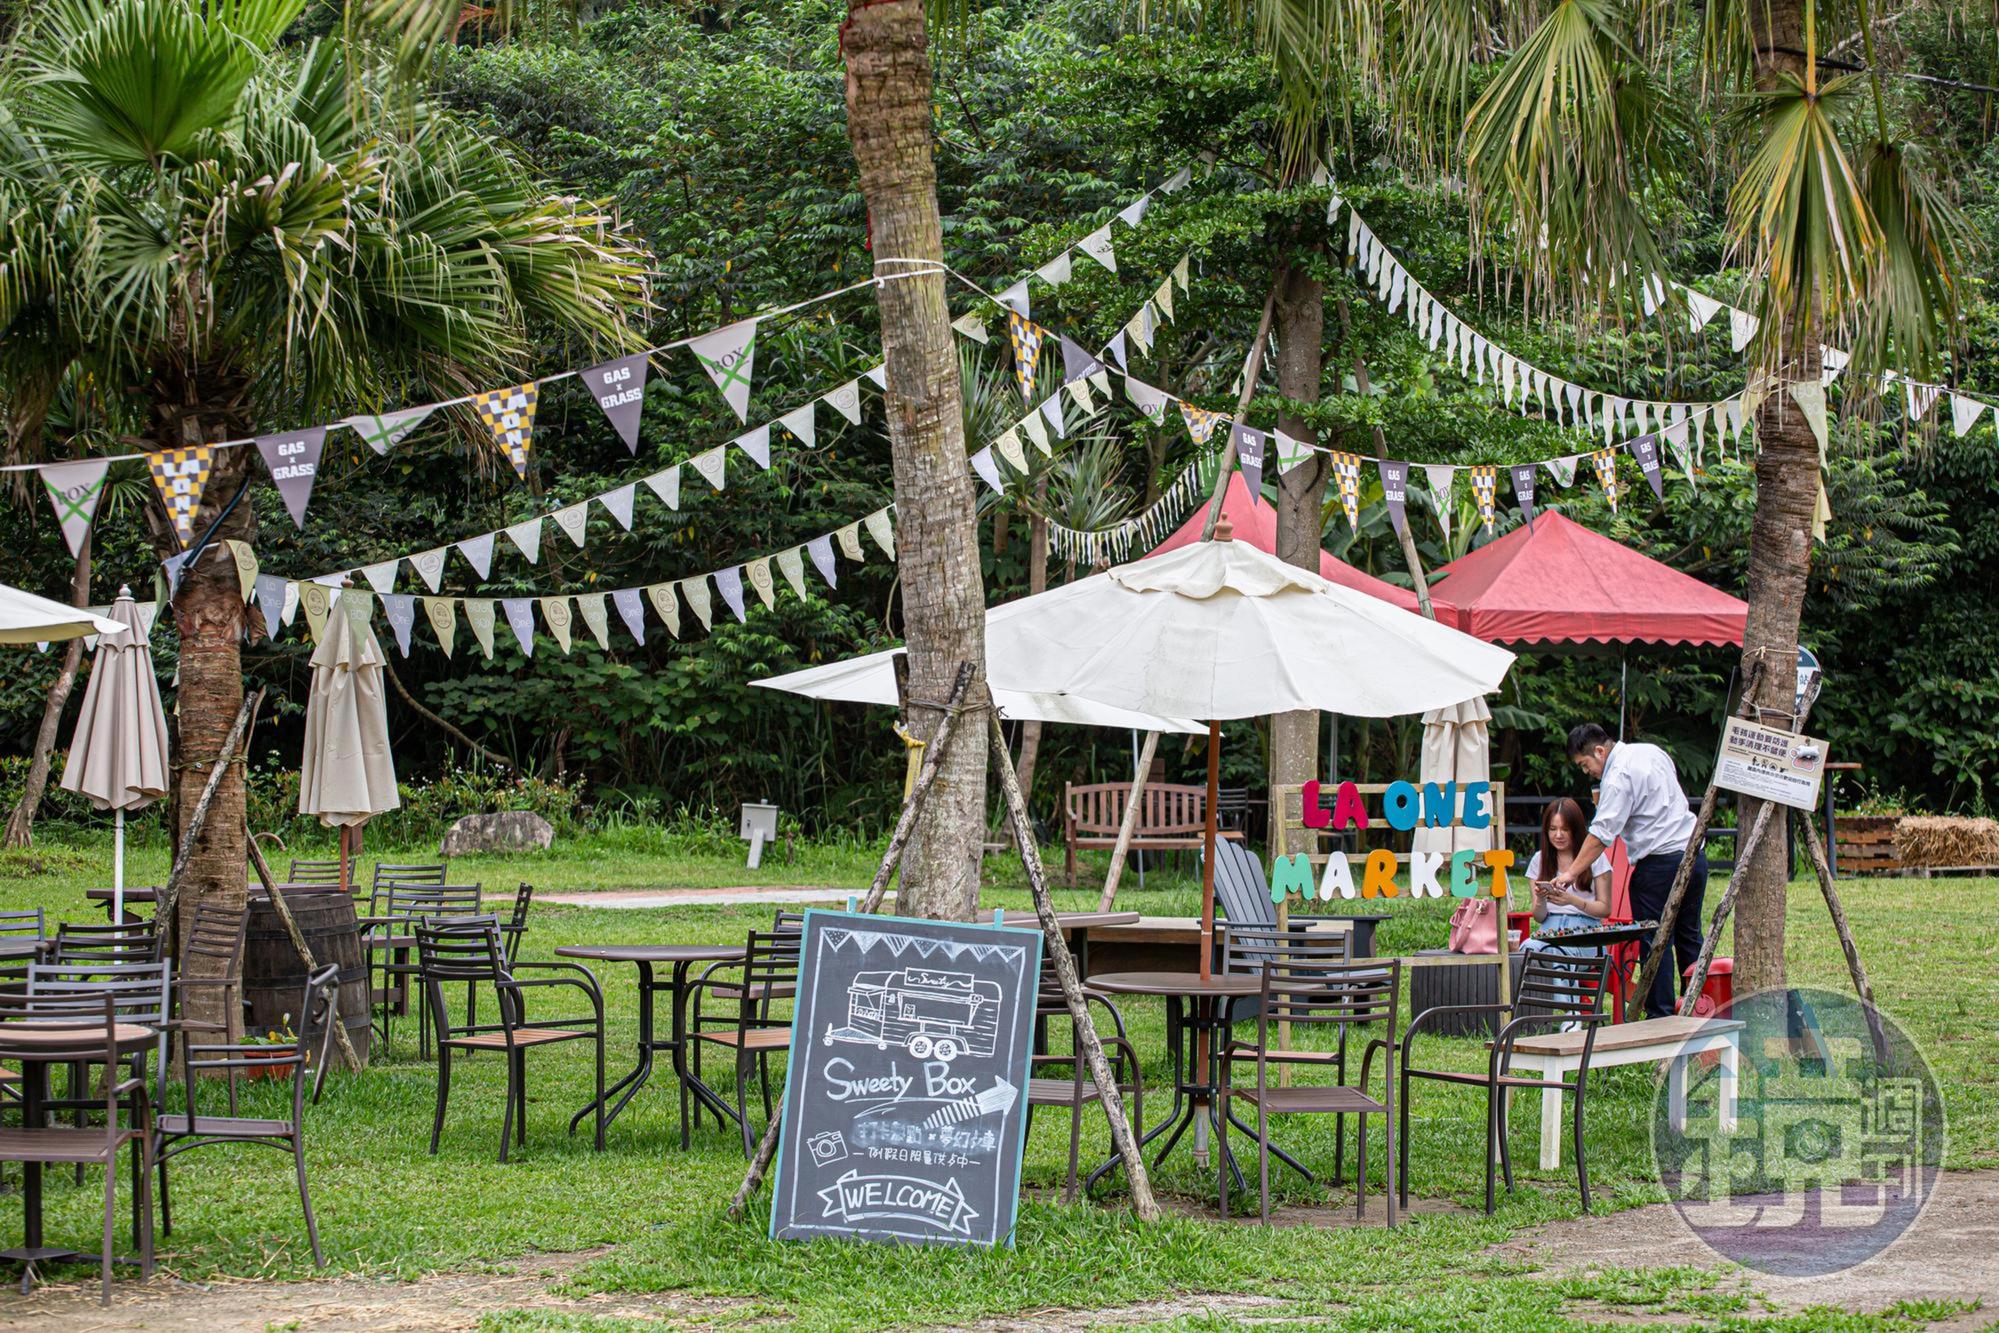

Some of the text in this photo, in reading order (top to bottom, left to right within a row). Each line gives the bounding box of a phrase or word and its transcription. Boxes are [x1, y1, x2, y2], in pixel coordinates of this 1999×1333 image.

[603, 367, 632, 385] GAS
[600, 387, 643, 409] GRASS
[278, 441, 306, 457] GAS
[1242, 432, 1257, 446] GAS
[272, 463, 315, 481] GRASS
[1302, 779, 1491, 831] LA ONE
[1271, 849, 1515, 904] MARKET
[823, 1057, 977, 1102] Sweety Box
[844, 1181, 955, 1219] WELCOME
